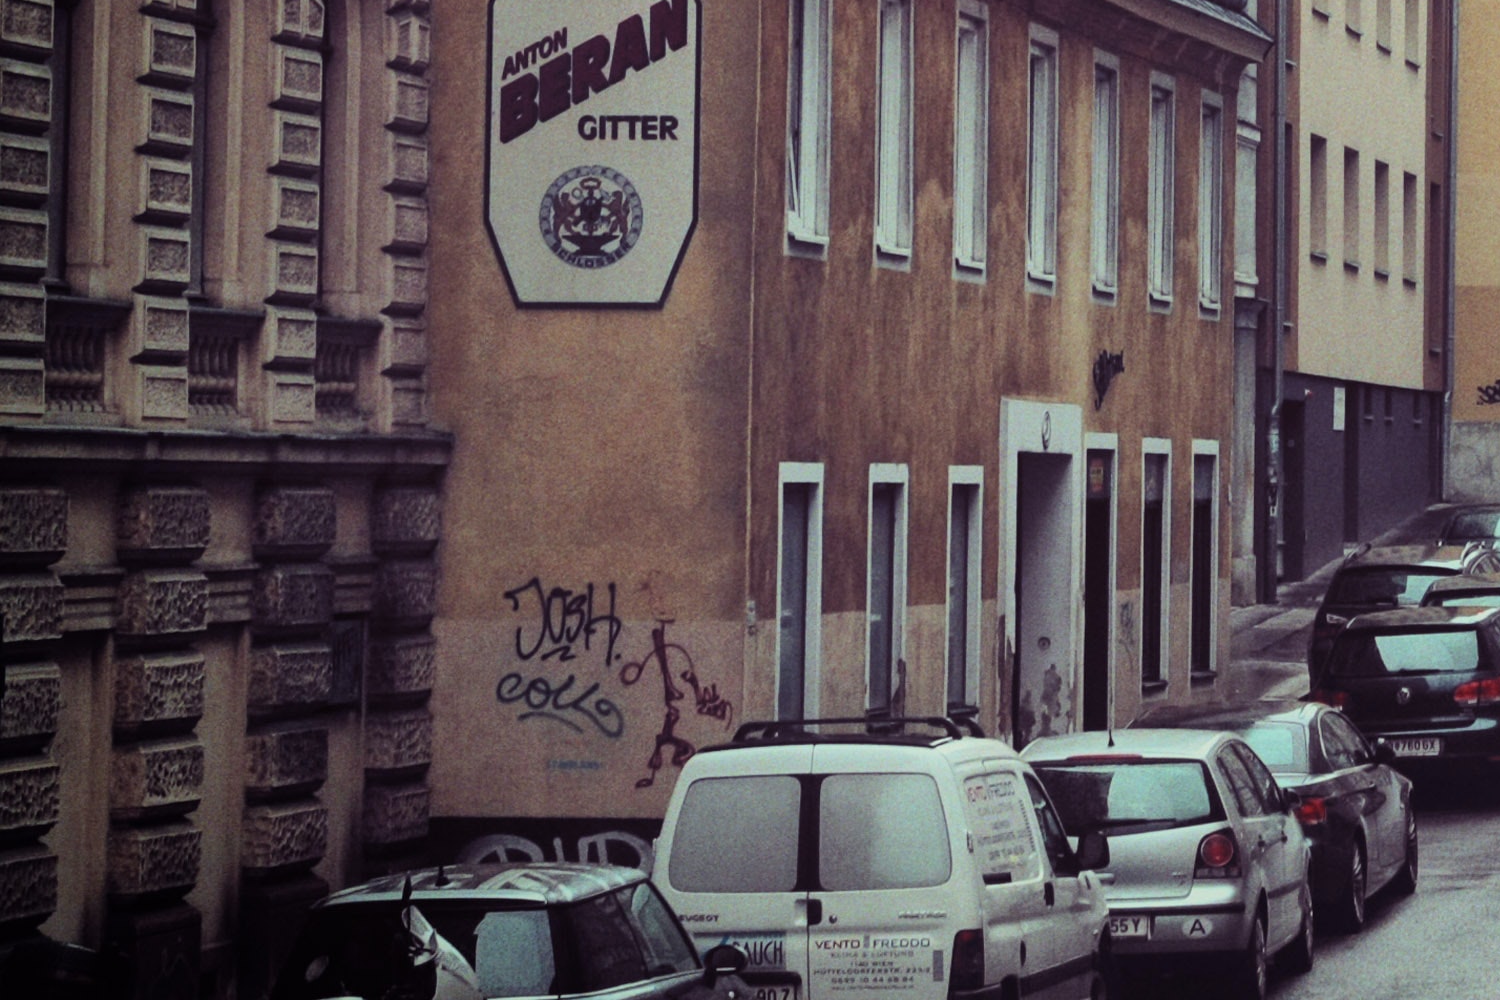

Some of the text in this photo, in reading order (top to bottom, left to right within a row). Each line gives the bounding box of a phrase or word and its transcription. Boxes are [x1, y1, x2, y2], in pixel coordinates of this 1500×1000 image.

[502, 27, 568, 80] ANTON
[578, 115, 678, 140] GITTER
[1190, 919, 1205, 935] A
[732, 941, 783, 966] AUCH
[815, 938, 930, 949] VENTO FREDDO
